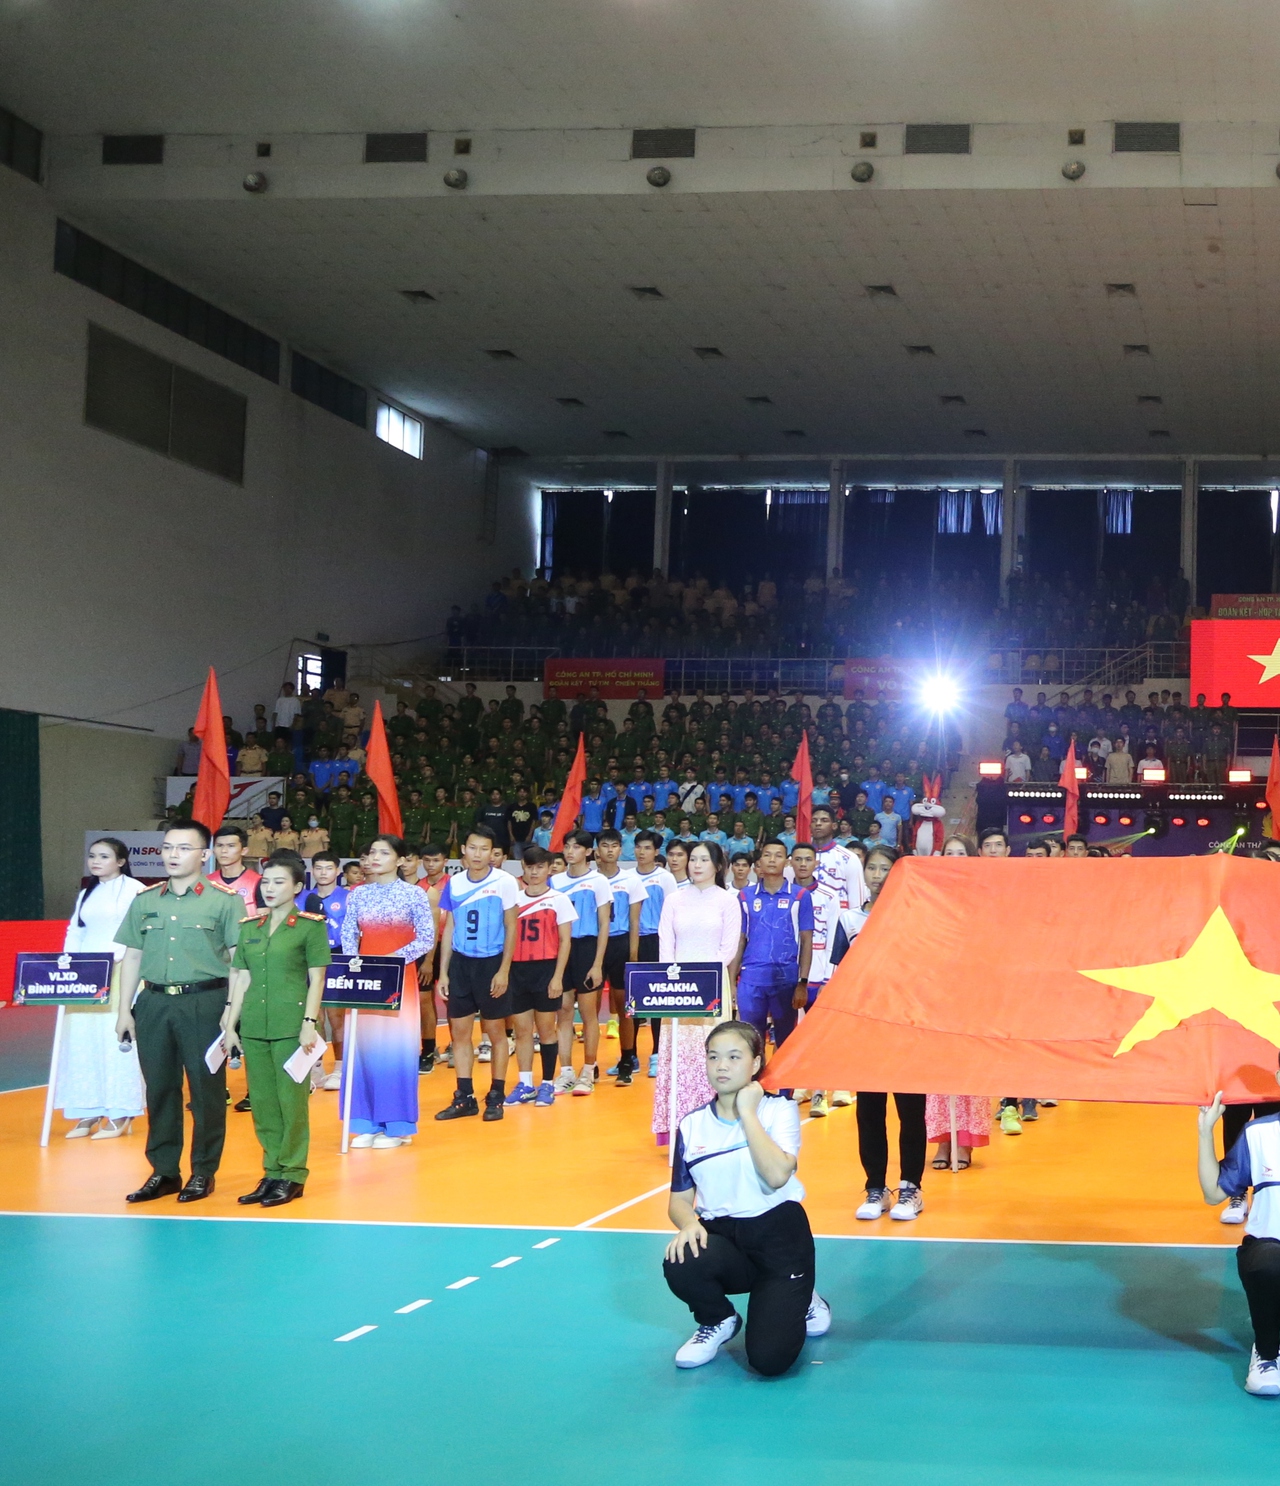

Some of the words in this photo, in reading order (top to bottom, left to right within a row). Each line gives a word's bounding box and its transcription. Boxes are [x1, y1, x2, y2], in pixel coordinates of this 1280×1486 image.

[467, 910, 479, 934] 9
[521, 919, 540, 941] 15
[48, 972, 78, 981] VLXD
[326, 975, 354, 989] BẾN
[356, 979, 382, 990] TRE
[28, 982, 55, 994] BÌNH
[56, 983, 98, 994] DƯƠNG
[648, 983, 698, 992] VISAKHA
[643, 996, 704, 1006] CAMBODIA
